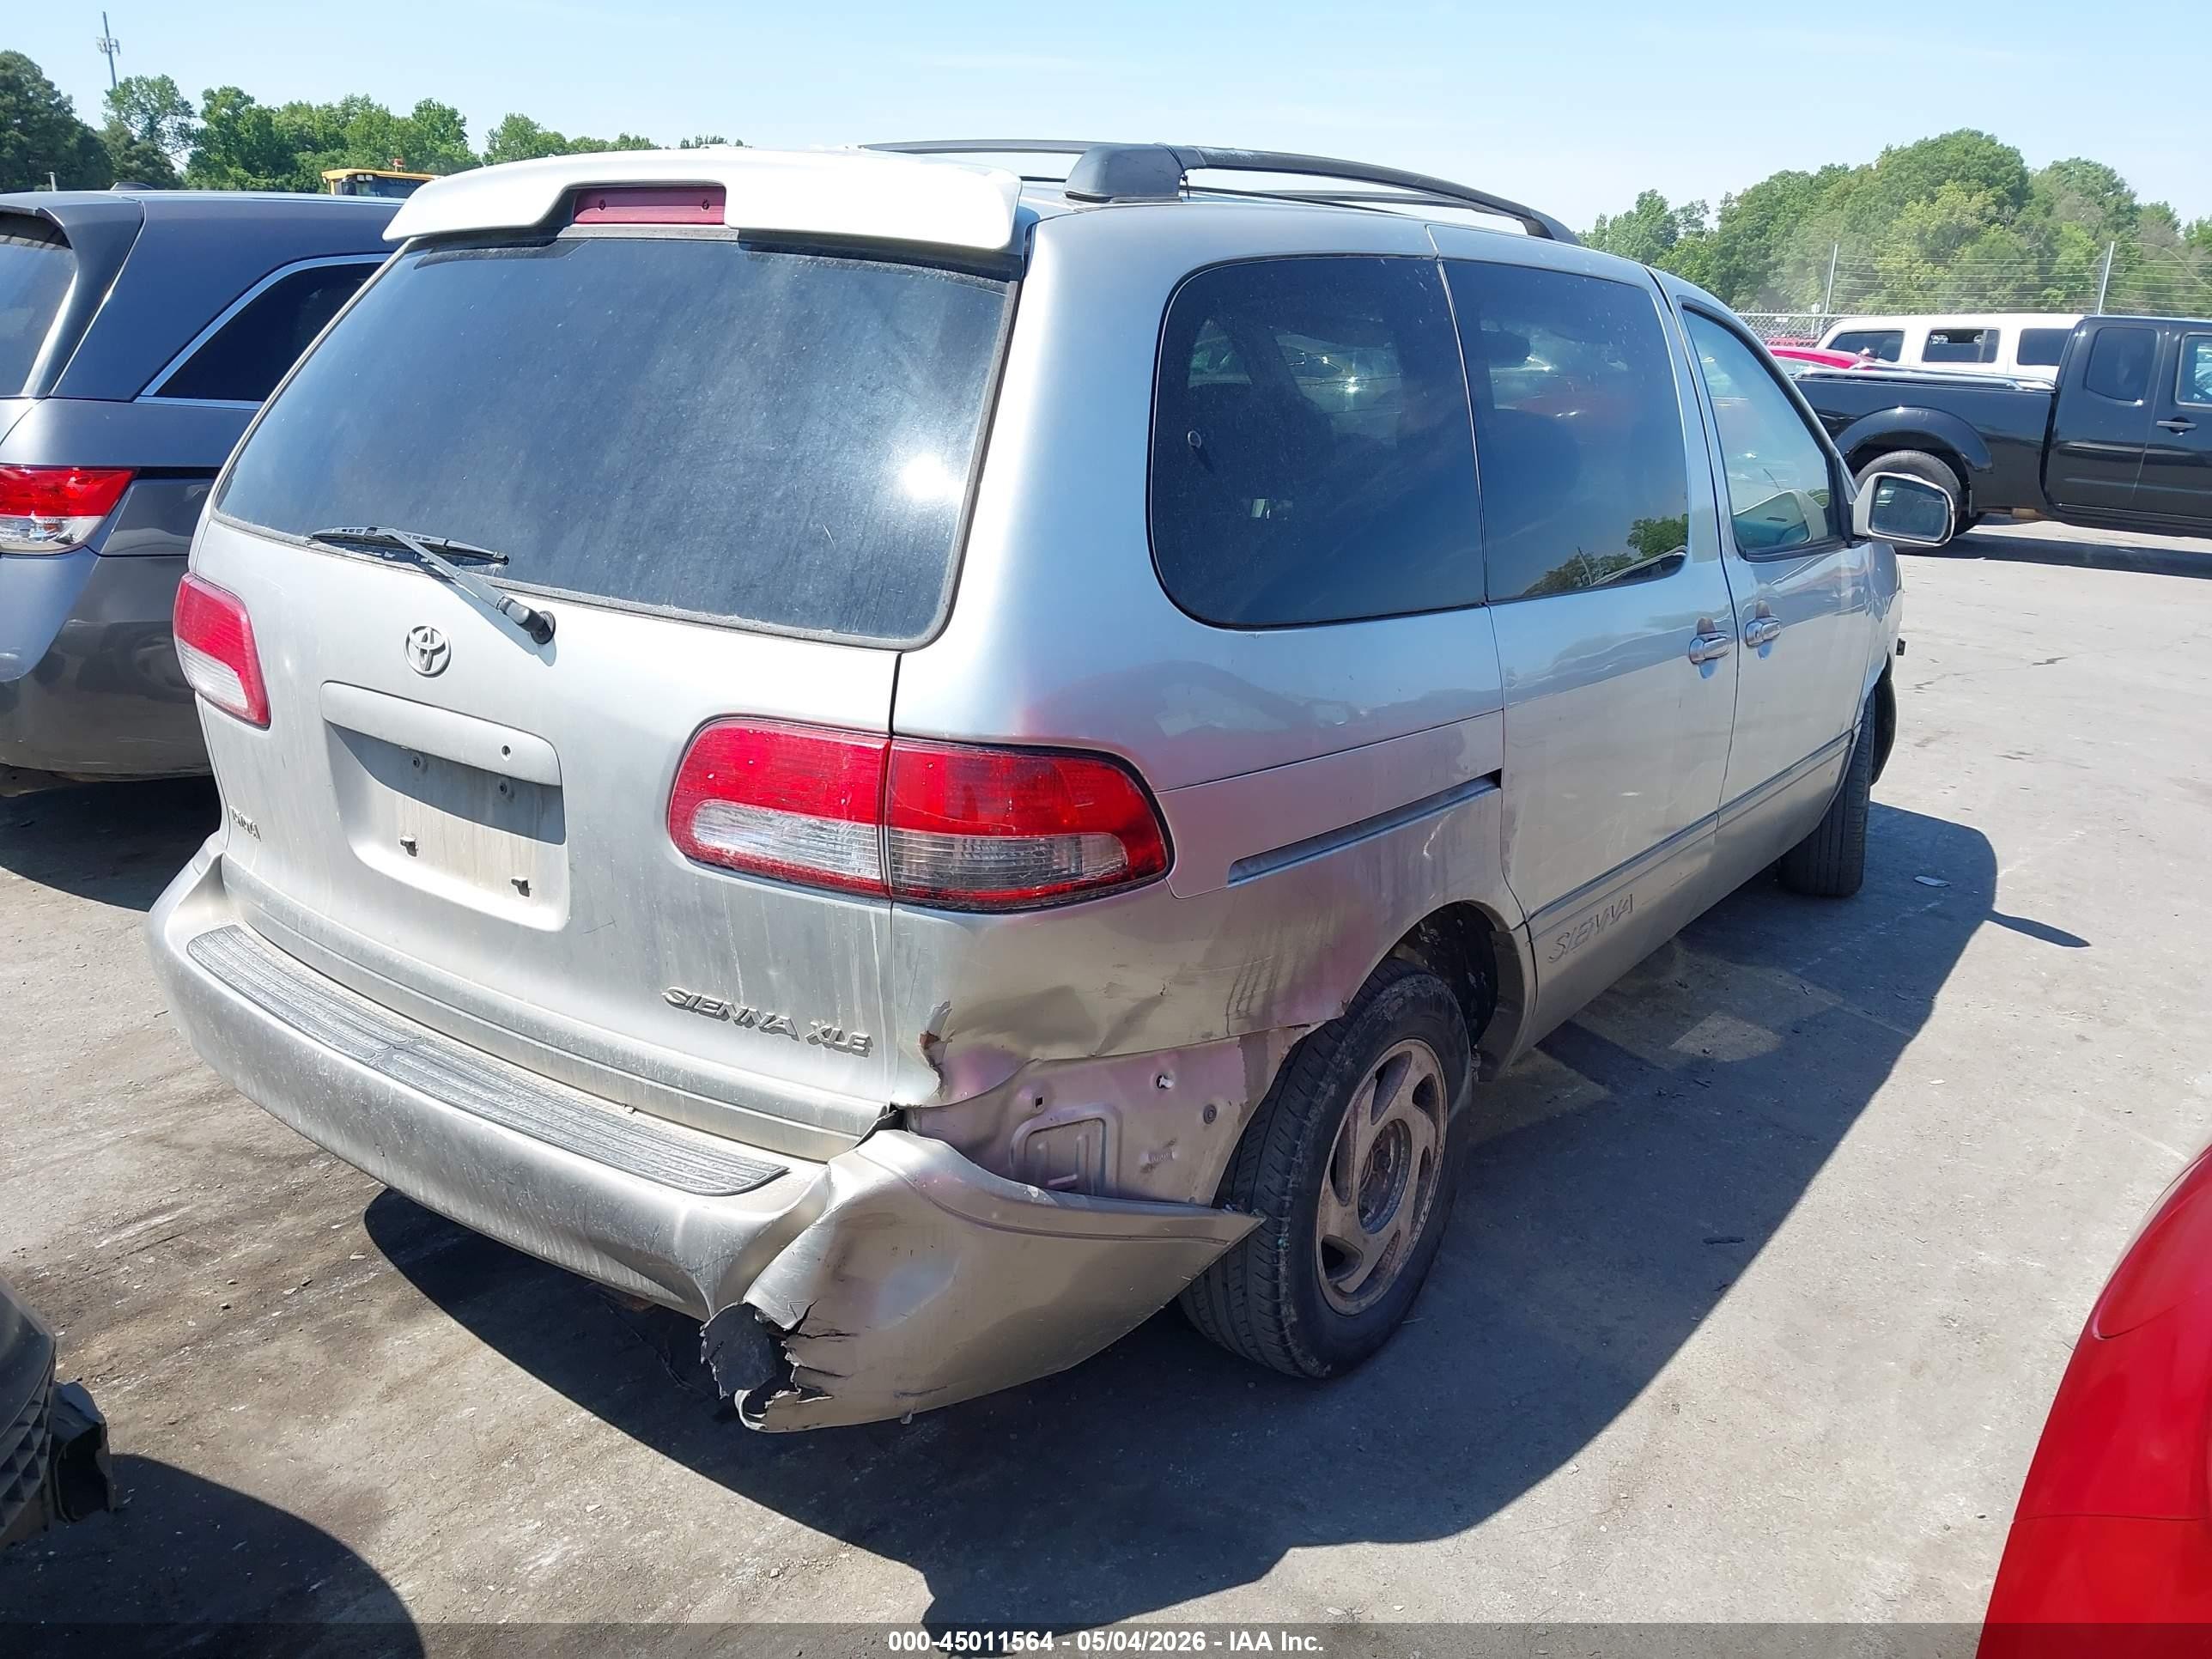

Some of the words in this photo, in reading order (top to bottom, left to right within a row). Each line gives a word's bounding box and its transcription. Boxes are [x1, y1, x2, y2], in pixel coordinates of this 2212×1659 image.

[1547, 893, 1633, 963] SIENNA
[661, 987, 800, 1042] SIENNA
[805, 1020, 874, 1058] XLE
